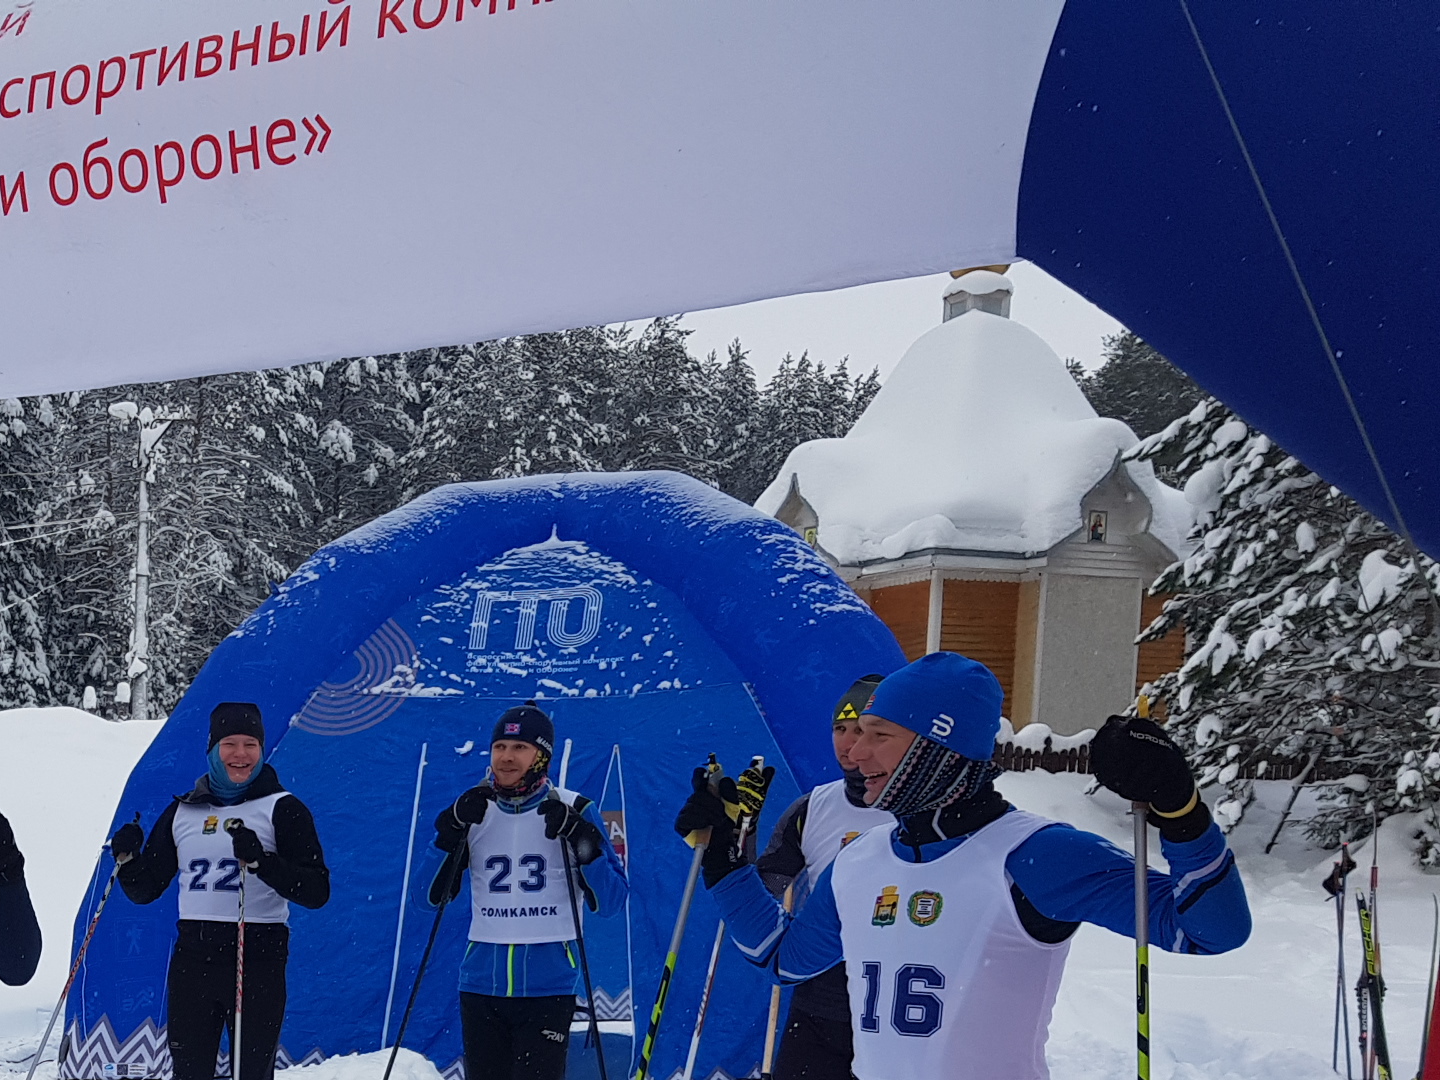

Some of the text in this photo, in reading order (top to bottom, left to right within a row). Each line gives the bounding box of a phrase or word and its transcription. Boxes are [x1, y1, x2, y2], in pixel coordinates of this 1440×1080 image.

[49, 114, 332, 205] обороне»
[468, 584, 603, 650] ГТО
[188, 857, 241, 892] 22
[485, 854, 547, 893] 23
[481, 905, 558, 918] СОЛИКАМСК
[861, 961, 946, 1037] 16
